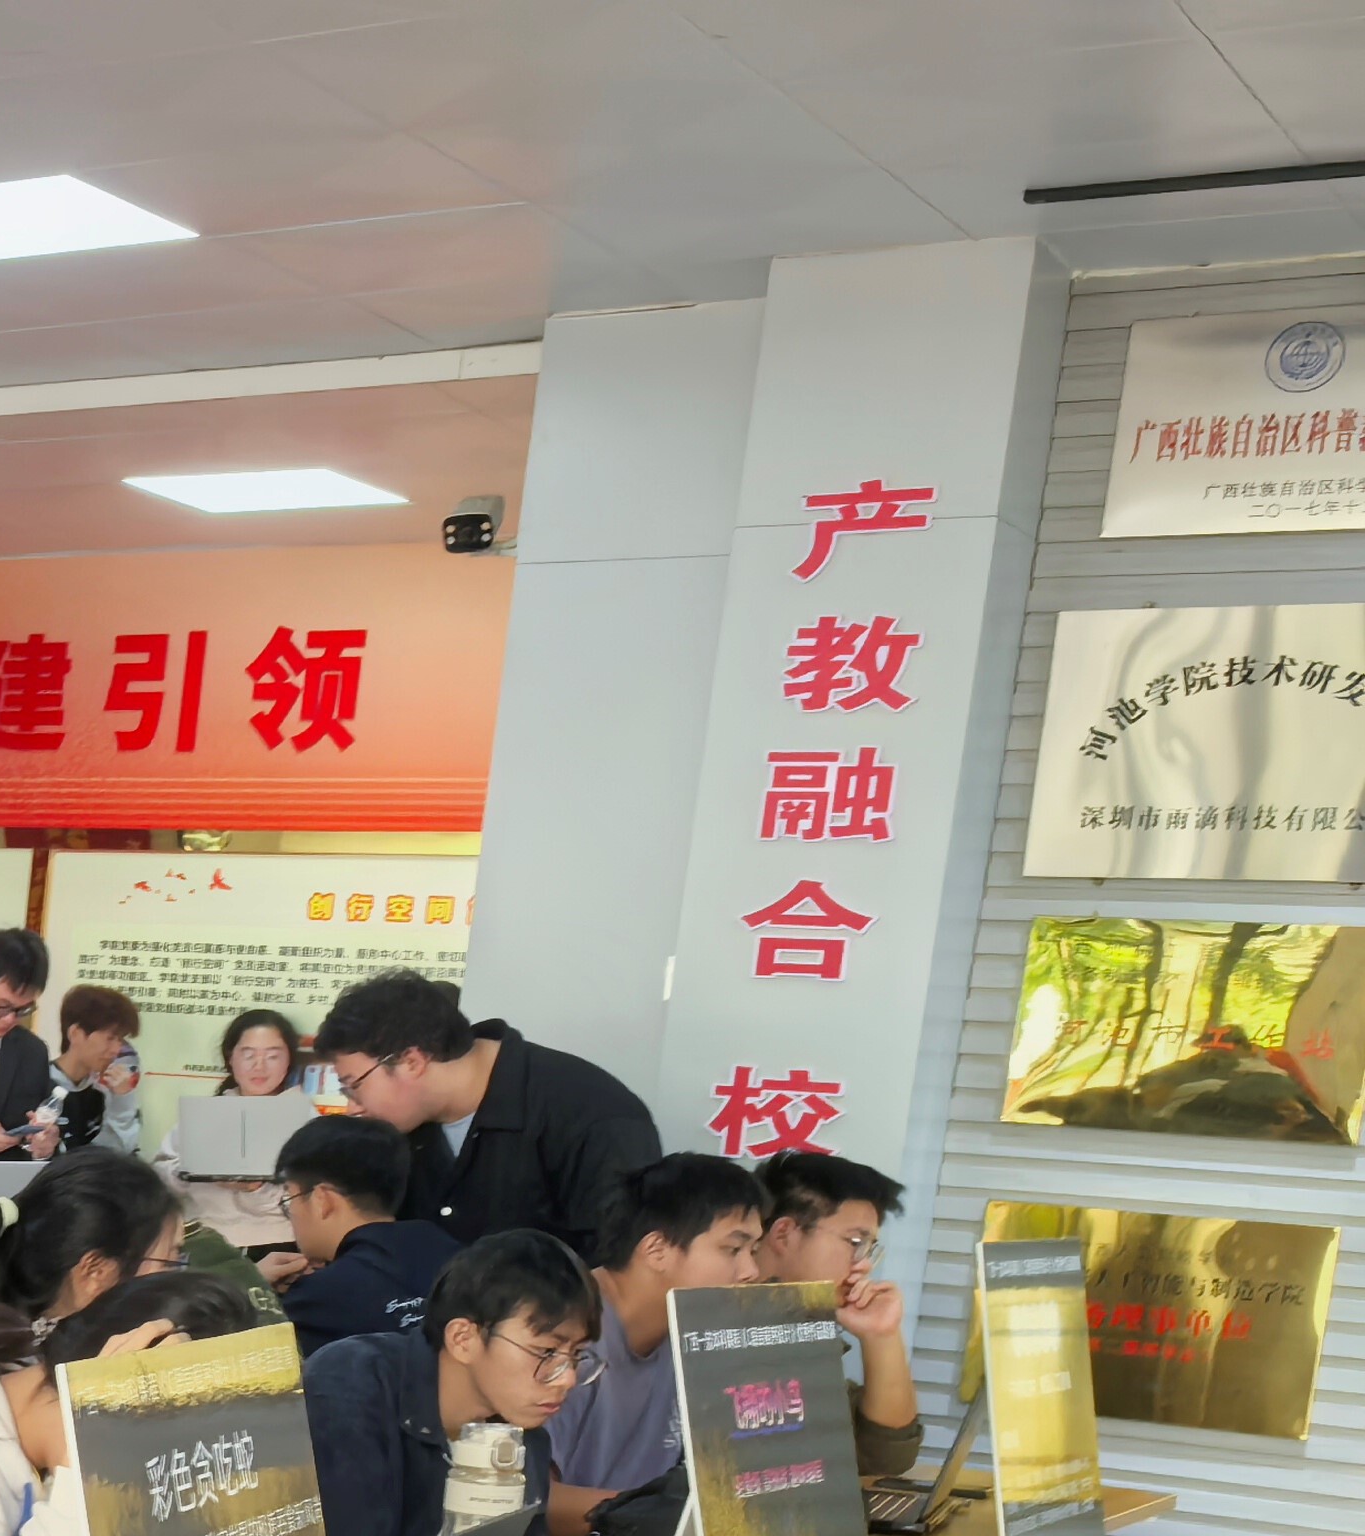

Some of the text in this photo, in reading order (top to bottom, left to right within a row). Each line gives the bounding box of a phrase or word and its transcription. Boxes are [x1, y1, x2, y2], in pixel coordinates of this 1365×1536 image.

[1130, 408, 1365, 464] 广西壮族自治区科普
[741, 479, 938, 981] 产教融合
[145, 1429, 260, 1522] 彩色贪吃蛇
